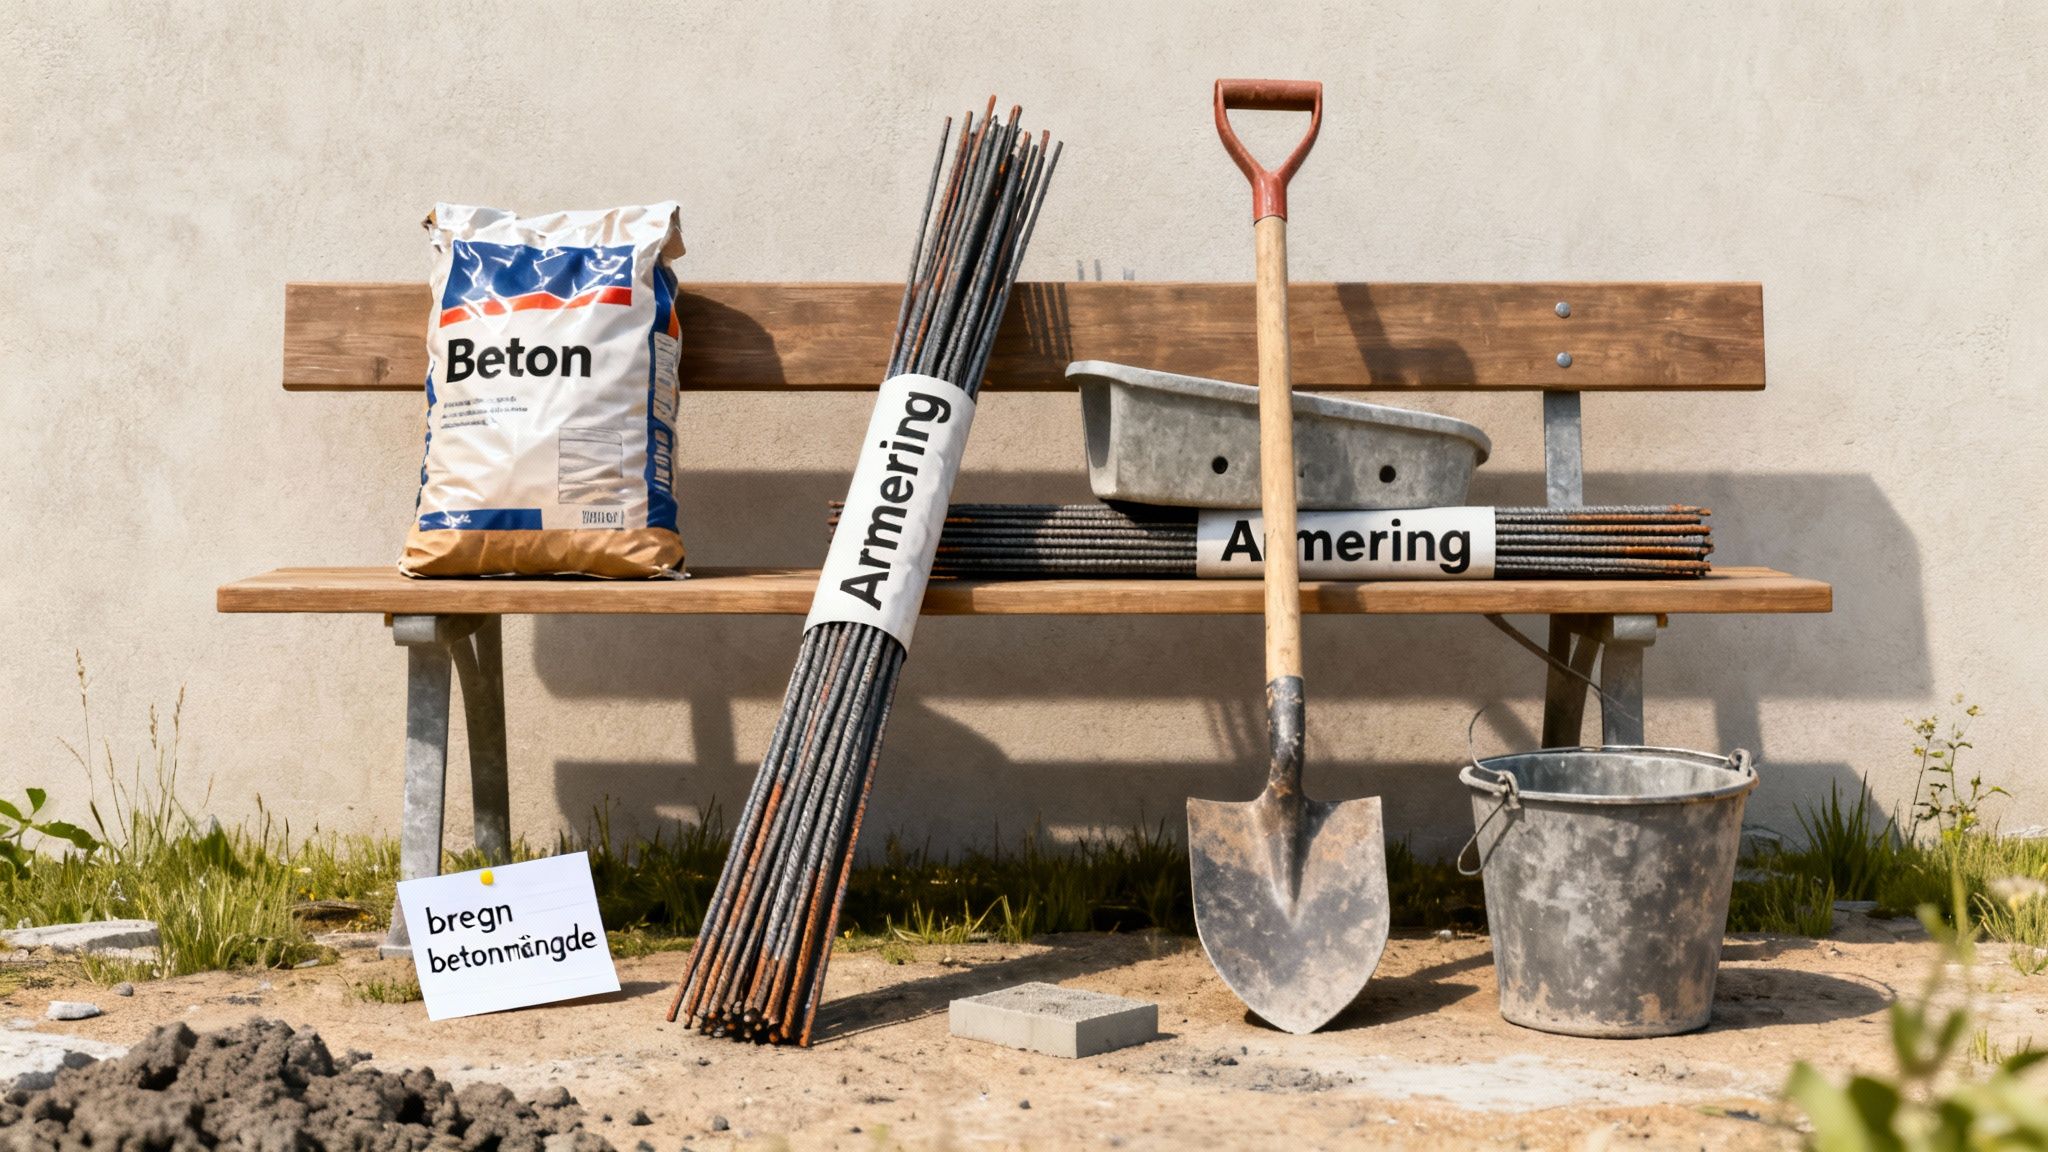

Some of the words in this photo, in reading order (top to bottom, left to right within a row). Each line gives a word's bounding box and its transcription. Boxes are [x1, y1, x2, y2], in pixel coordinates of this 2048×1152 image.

[446, 337, 592, 384] Beton
[839, 391, 952, 611] Armering
[1220, 518, 1471, 575] Amering
[425, 904, 513, 935] bregn
